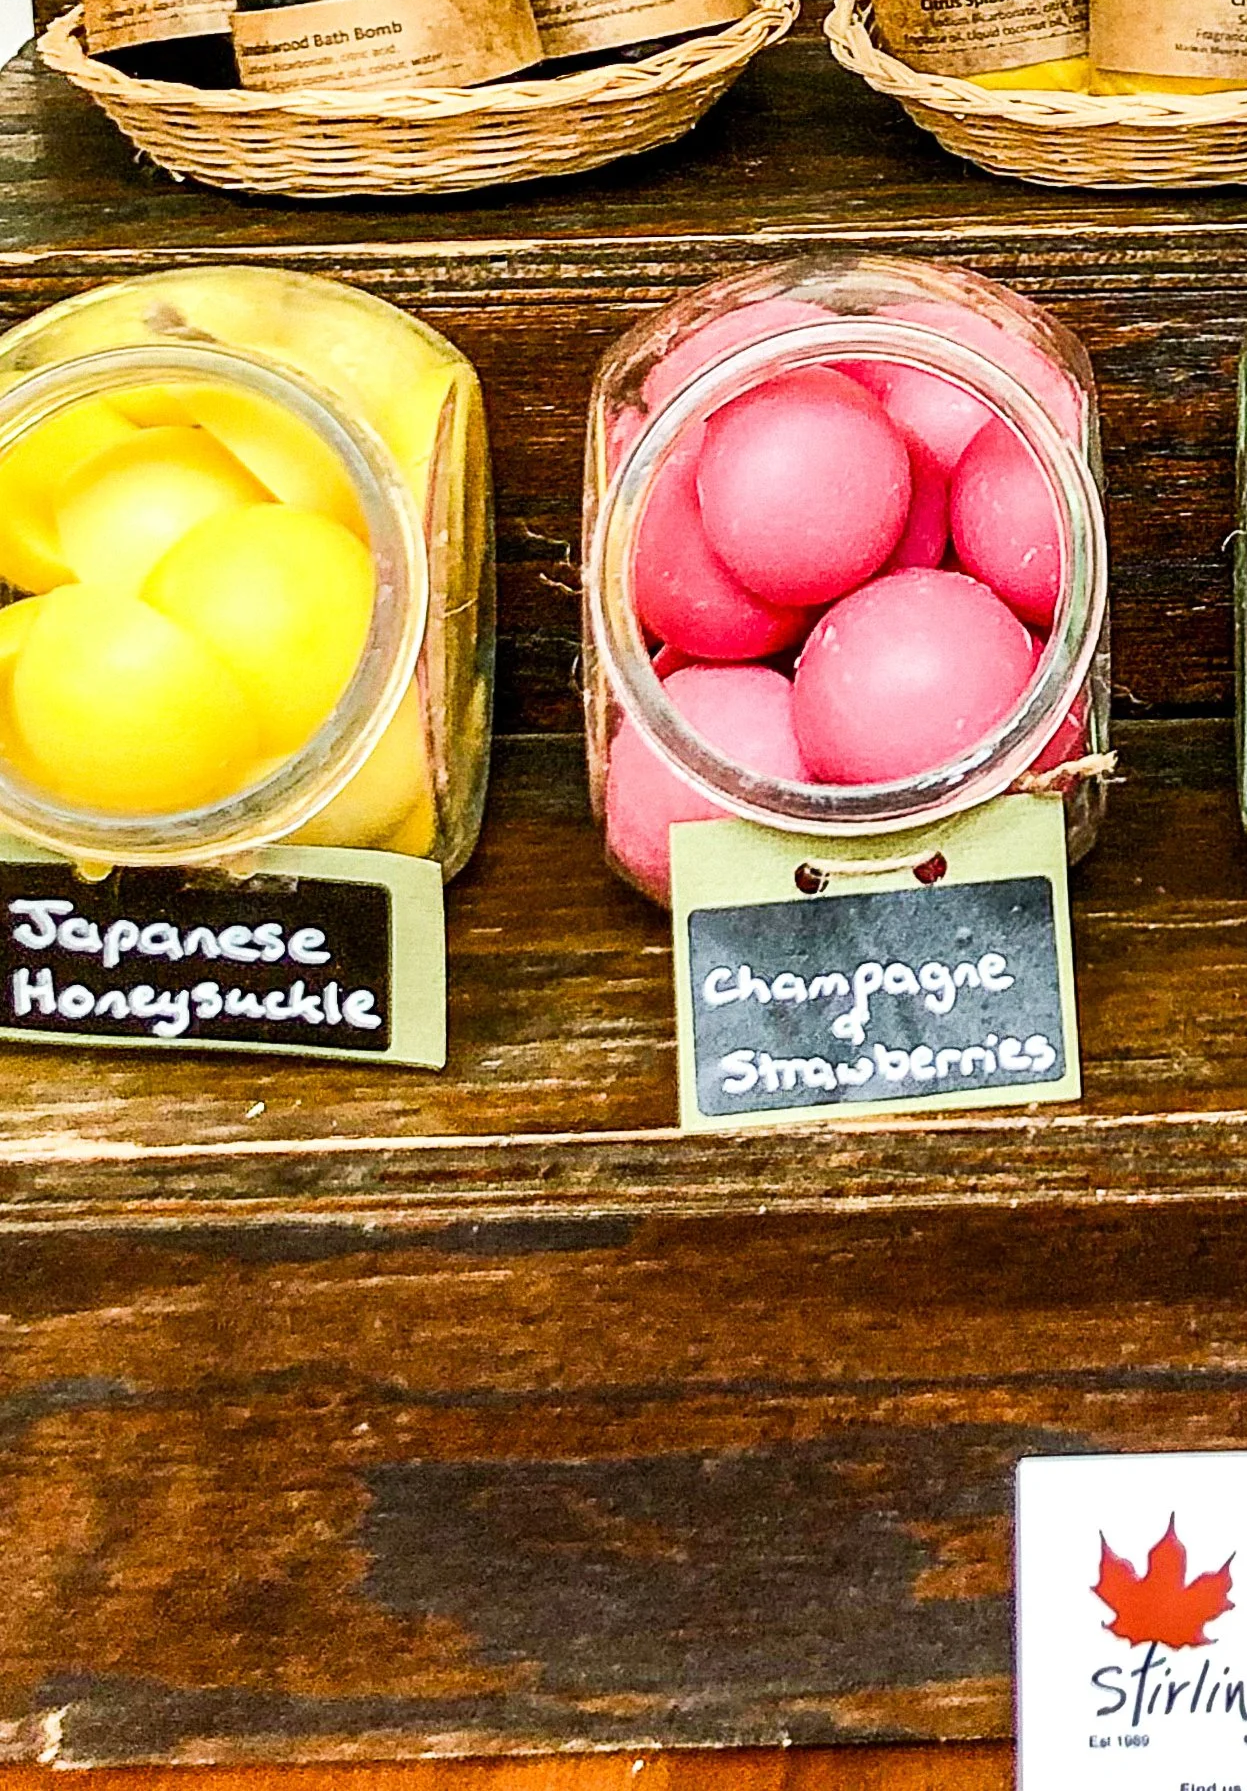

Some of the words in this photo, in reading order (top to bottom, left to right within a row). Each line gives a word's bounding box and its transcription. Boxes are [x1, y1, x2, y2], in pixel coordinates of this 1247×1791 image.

[314, 30, 349, 48] Bath
[354, 21, 403, 41] Bomb
[967, 27, 1000, 41] Liquid
[1002, 22, 1046, 35] coconut
[8, 898, 331, 968] Japanese
[13, 967, 382, 1038] Honeysuckle
[702, 952, 1015, 1015] Champagne
[721, 1033, 1057, 1095] Strawberries
